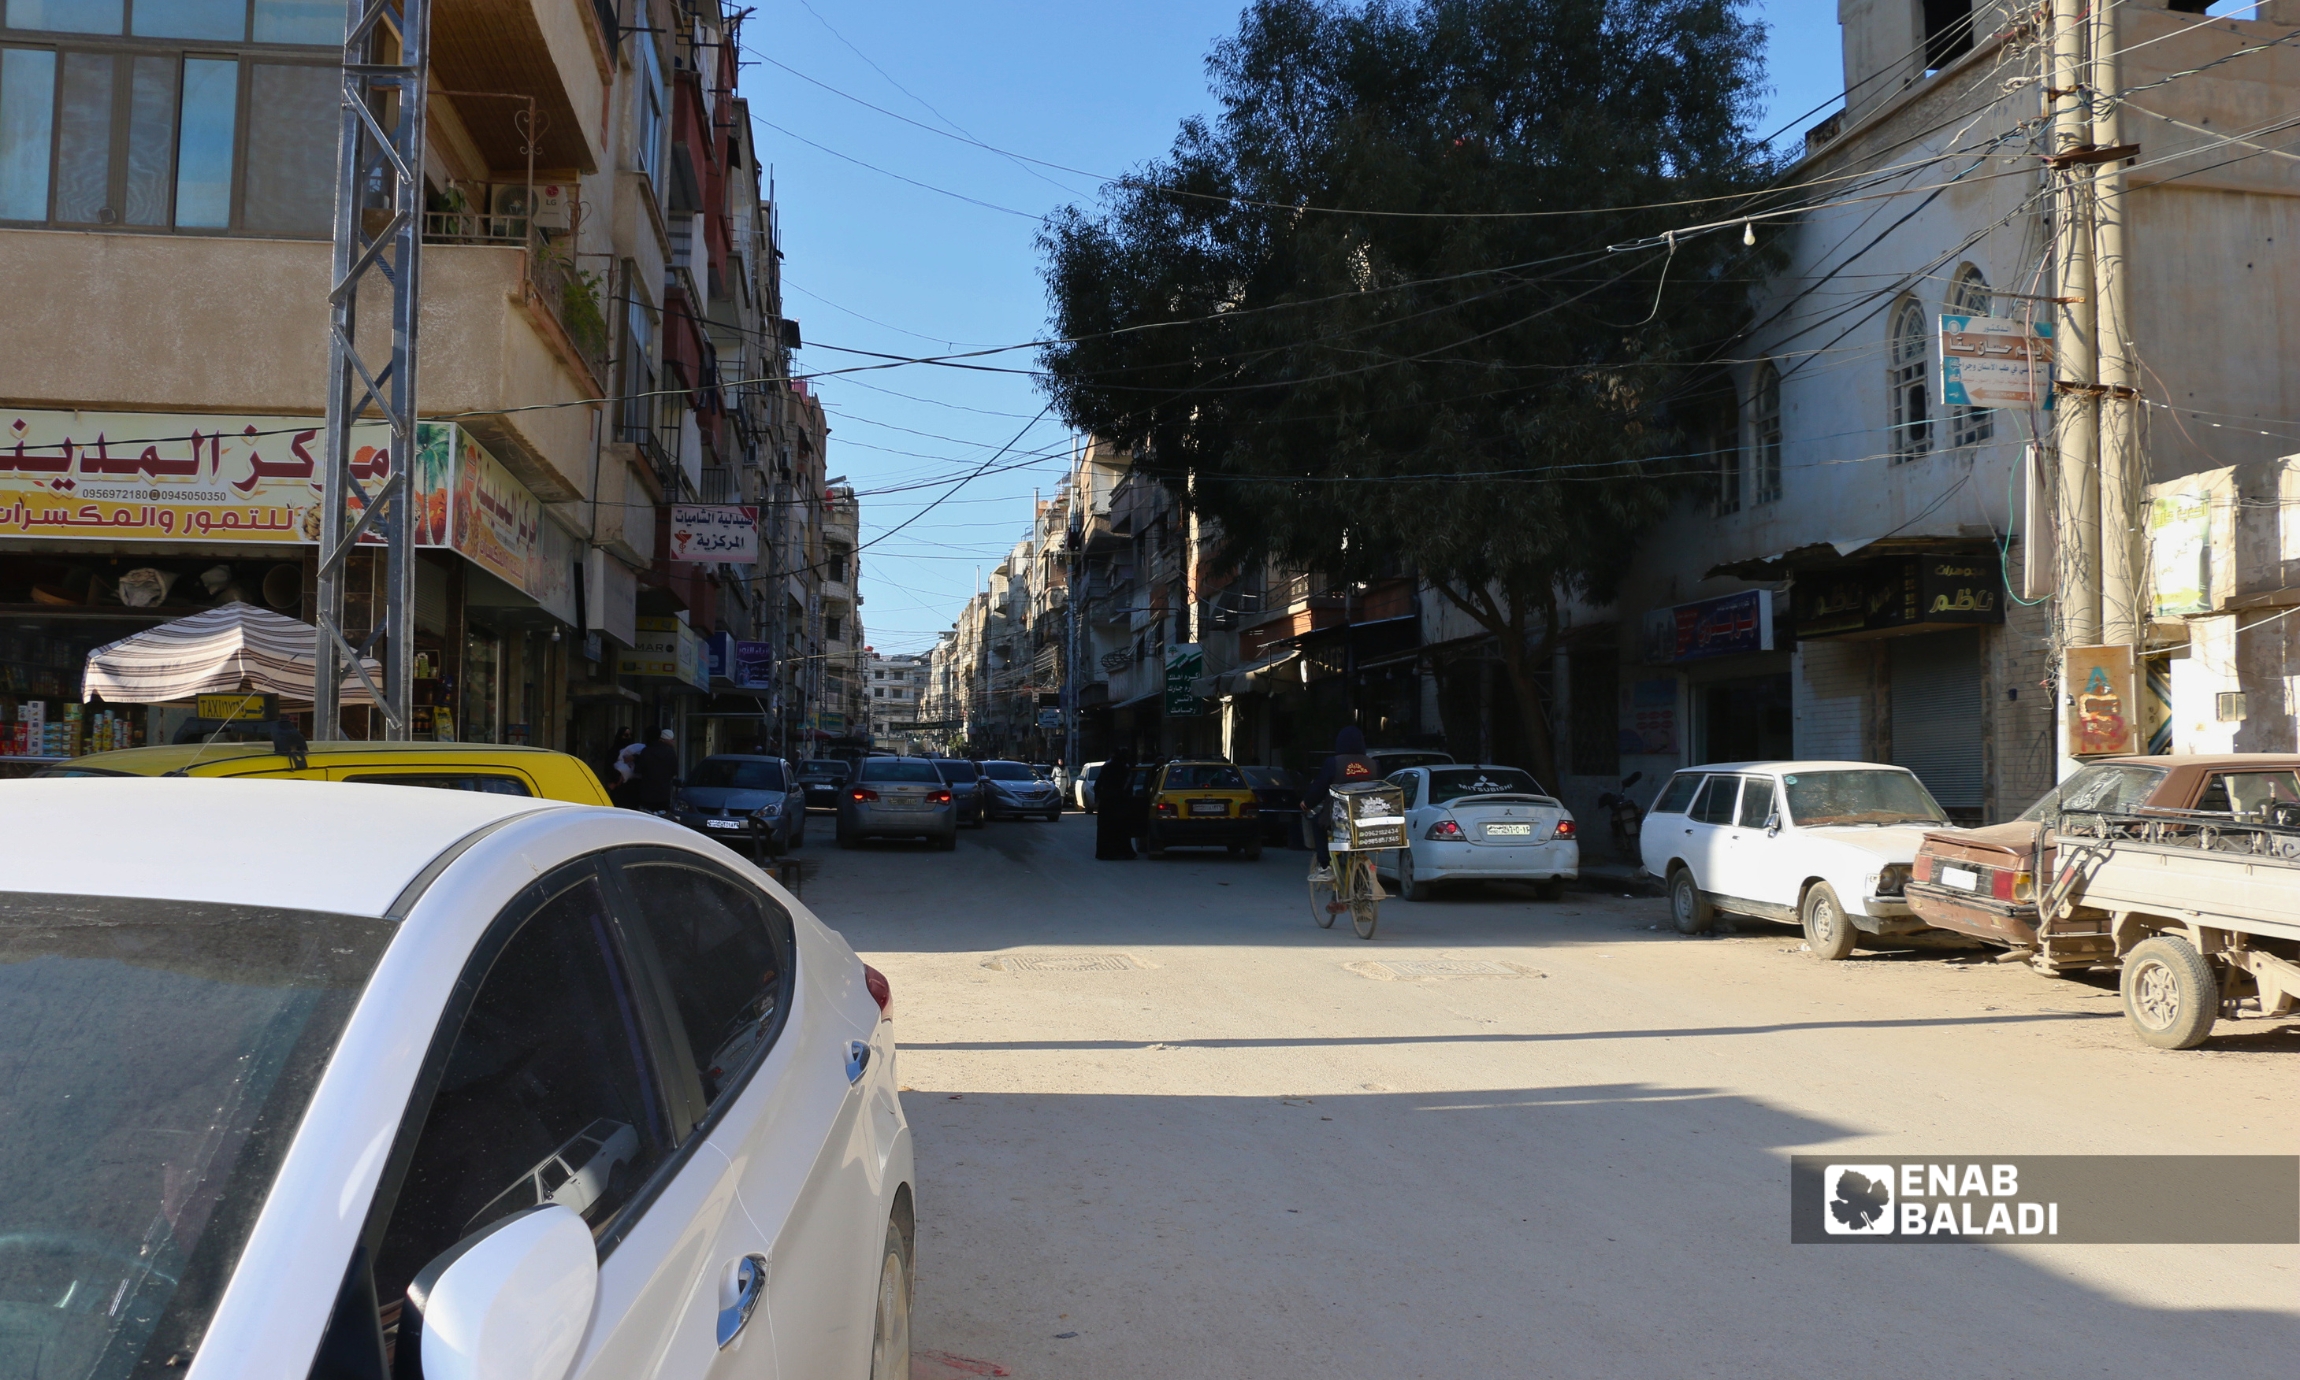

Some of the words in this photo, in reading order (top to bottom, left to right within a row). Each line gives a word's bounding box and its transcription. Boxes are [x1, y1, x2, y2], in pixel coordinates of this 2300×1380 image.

[0, 418, 220, 492] المدين
[82, 488, 147, 500] 0956972180
[161, 490, 226, 501] 0945050350
[182, 508, 294, 535] للتمور
[718, 511, 754, 529] صيدلية
[696, 532, 744, 551] المركزية
[1934, 564, 1987, 578] مجوهرات
[1928, 587, 1995, 614] ناظم
[201, 700, 222, 718] TAXI
[1458, 783, 1513, 793] MITSUBISHI
